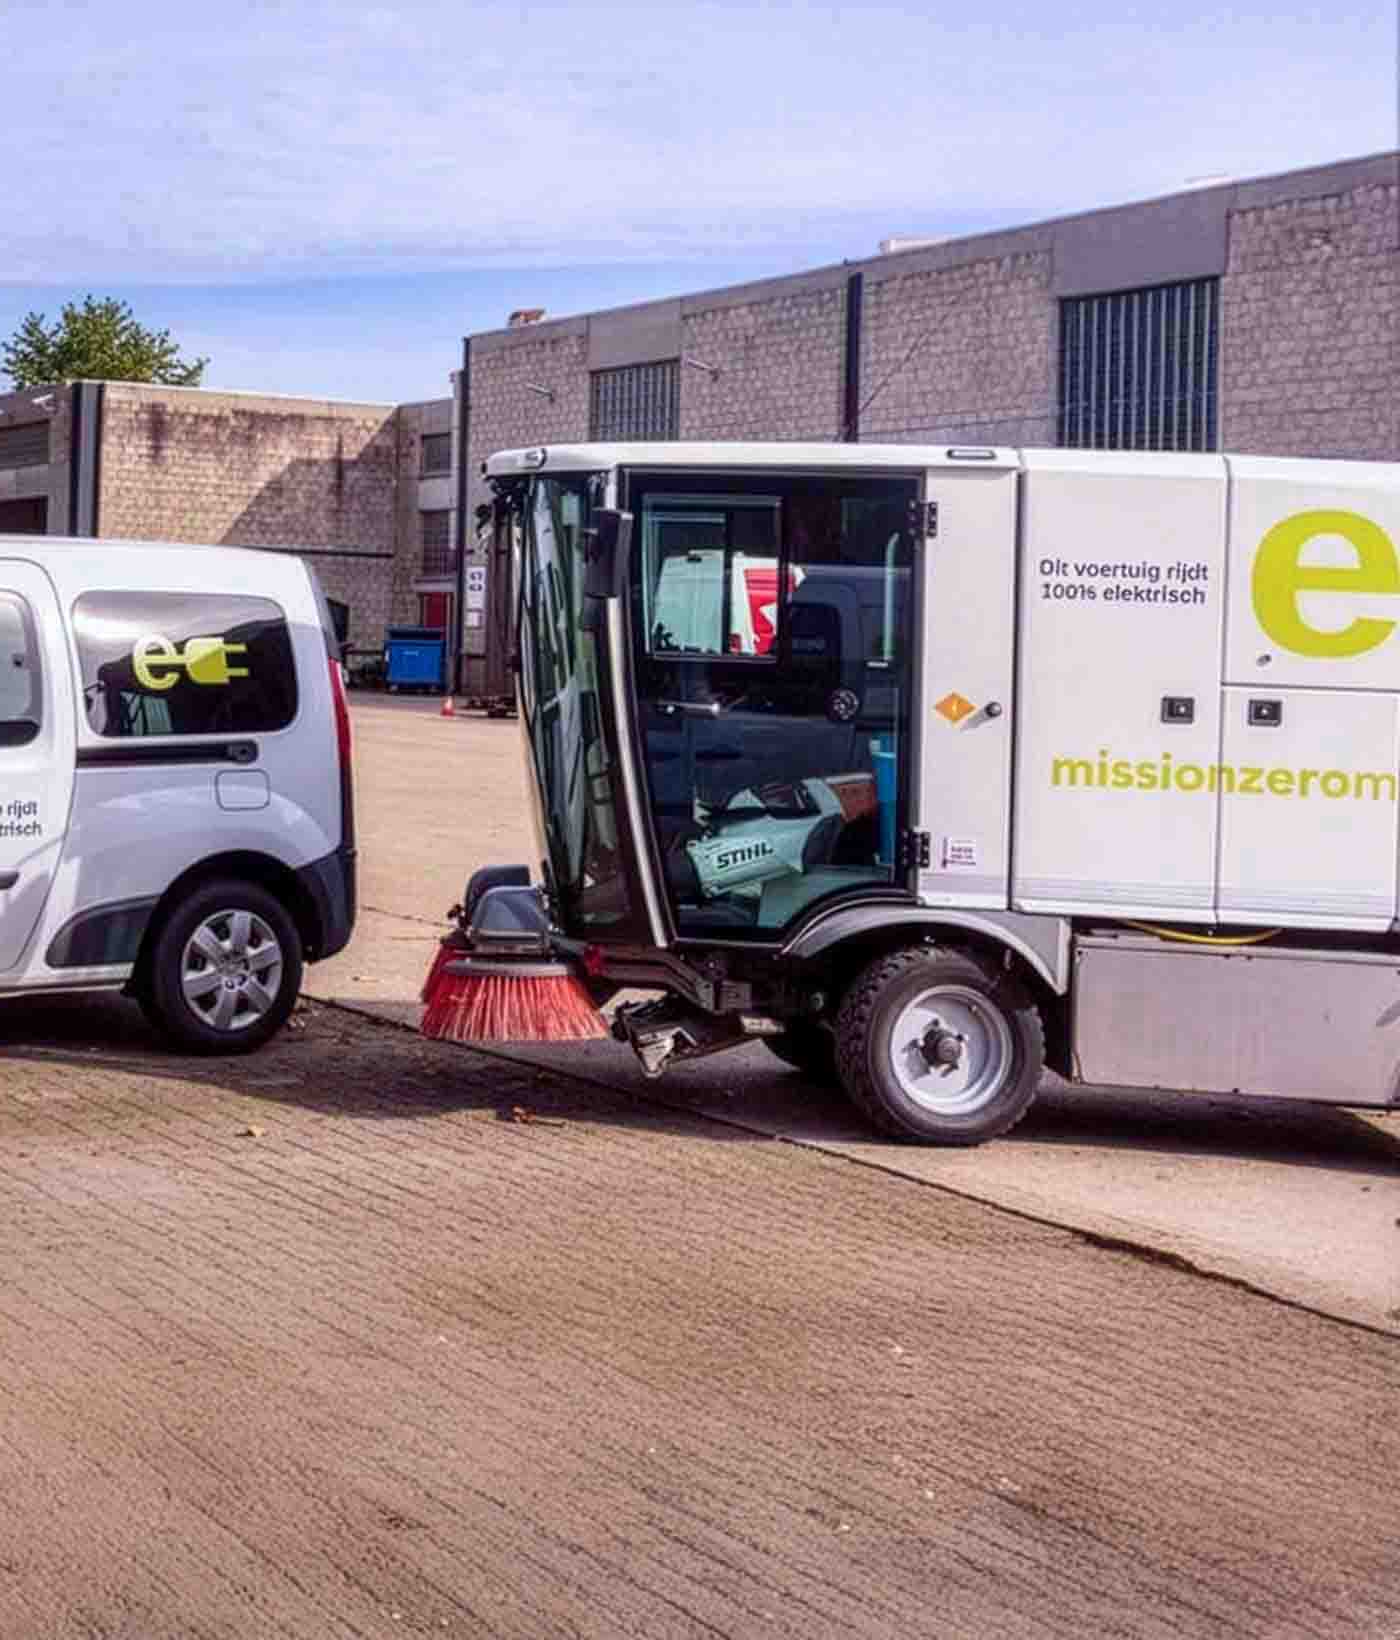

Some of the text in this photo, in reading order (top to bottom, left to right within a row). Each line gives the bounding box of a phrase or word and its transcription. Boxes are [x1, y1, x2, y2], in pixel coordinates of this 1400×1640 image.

[1074, 561, 1160, 583] voertuig
[1166, 561, 1208, 583] rijdt
[1102, 584, 1206, 605] elektrisch
[717, 842, 774, 869] STIHL
